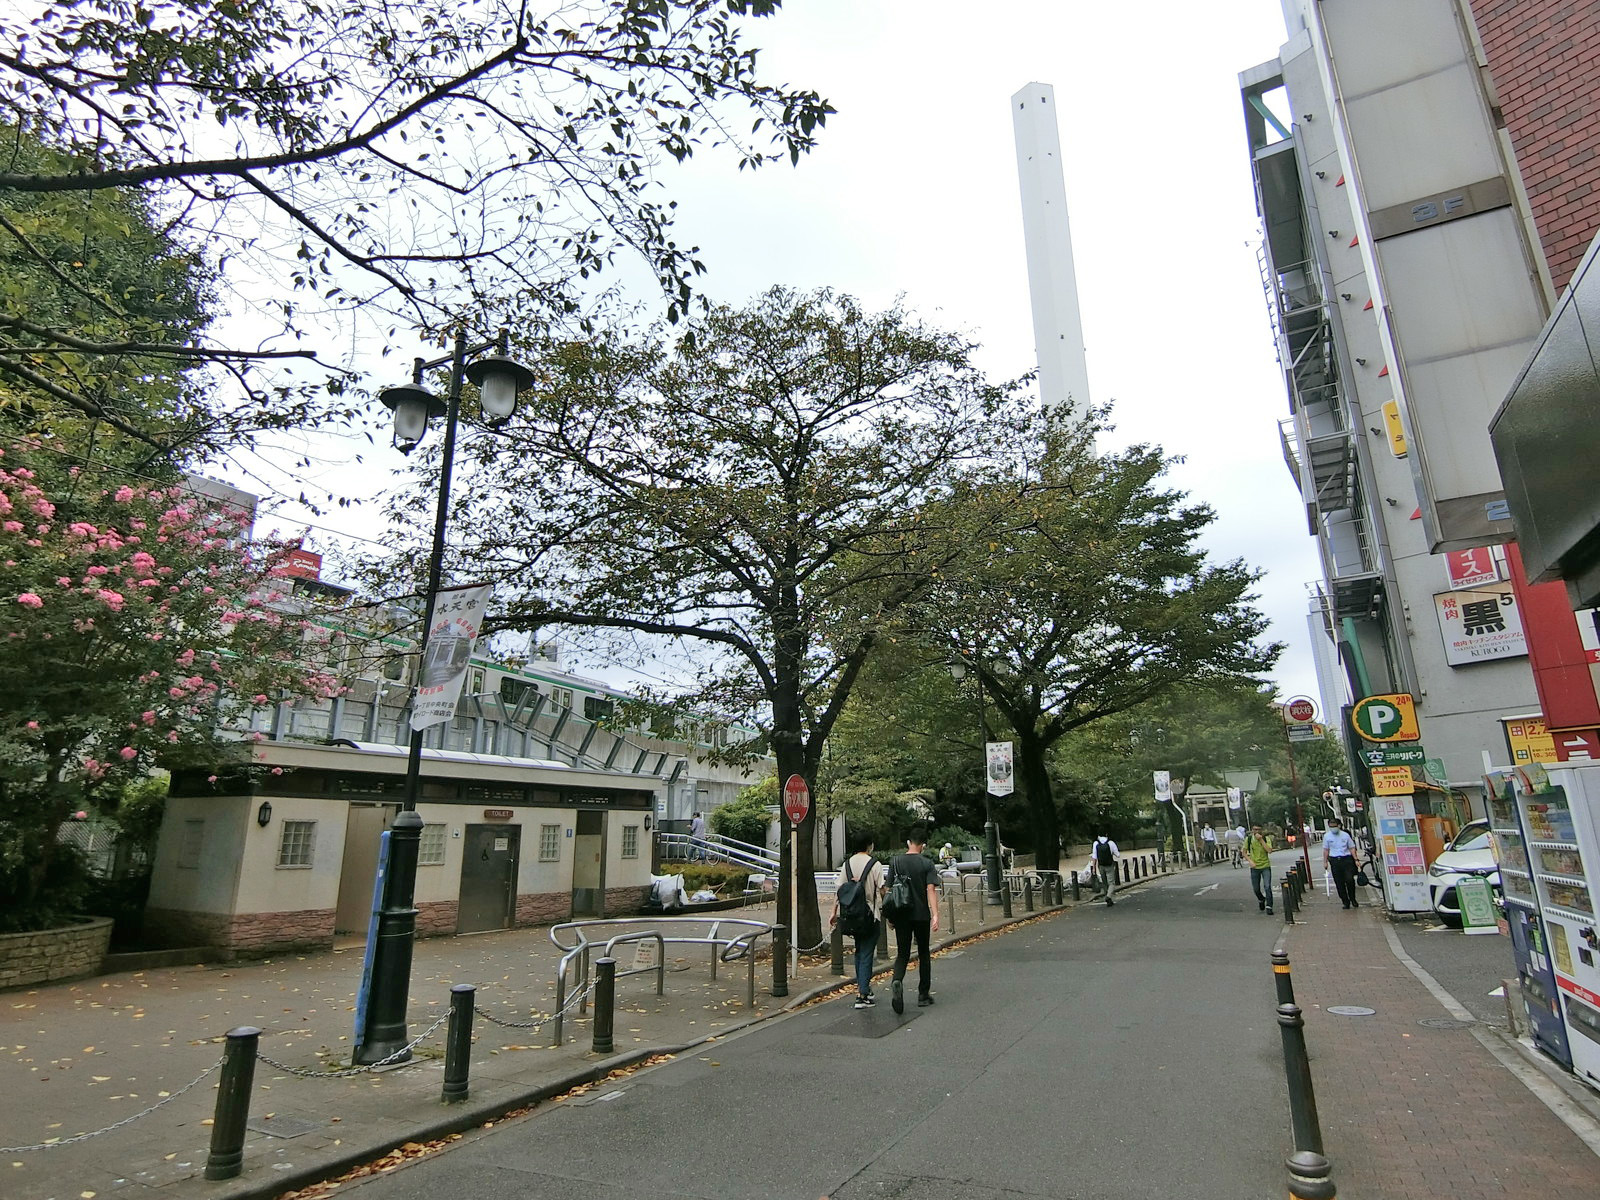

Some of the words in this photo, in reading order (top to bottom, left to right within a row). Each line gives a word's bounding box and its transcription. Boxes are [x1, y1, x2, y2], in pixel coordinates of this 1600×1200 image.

[1411, 195, 1464, 222] 3F
[436, 599, 479, 614] 水天宮
[1442, 598, 1459, 621] 焼肉
[1470, 645, 1510, 657] KUROGO
[1396, 696, 1410, 705] 24h
[1291, 705, 1312, 715] 消火栓
[1368, 705, 1394, 734] P
[1400, 731, 1418, 739] Repark
[1367, 750, 1386, 766] 空
